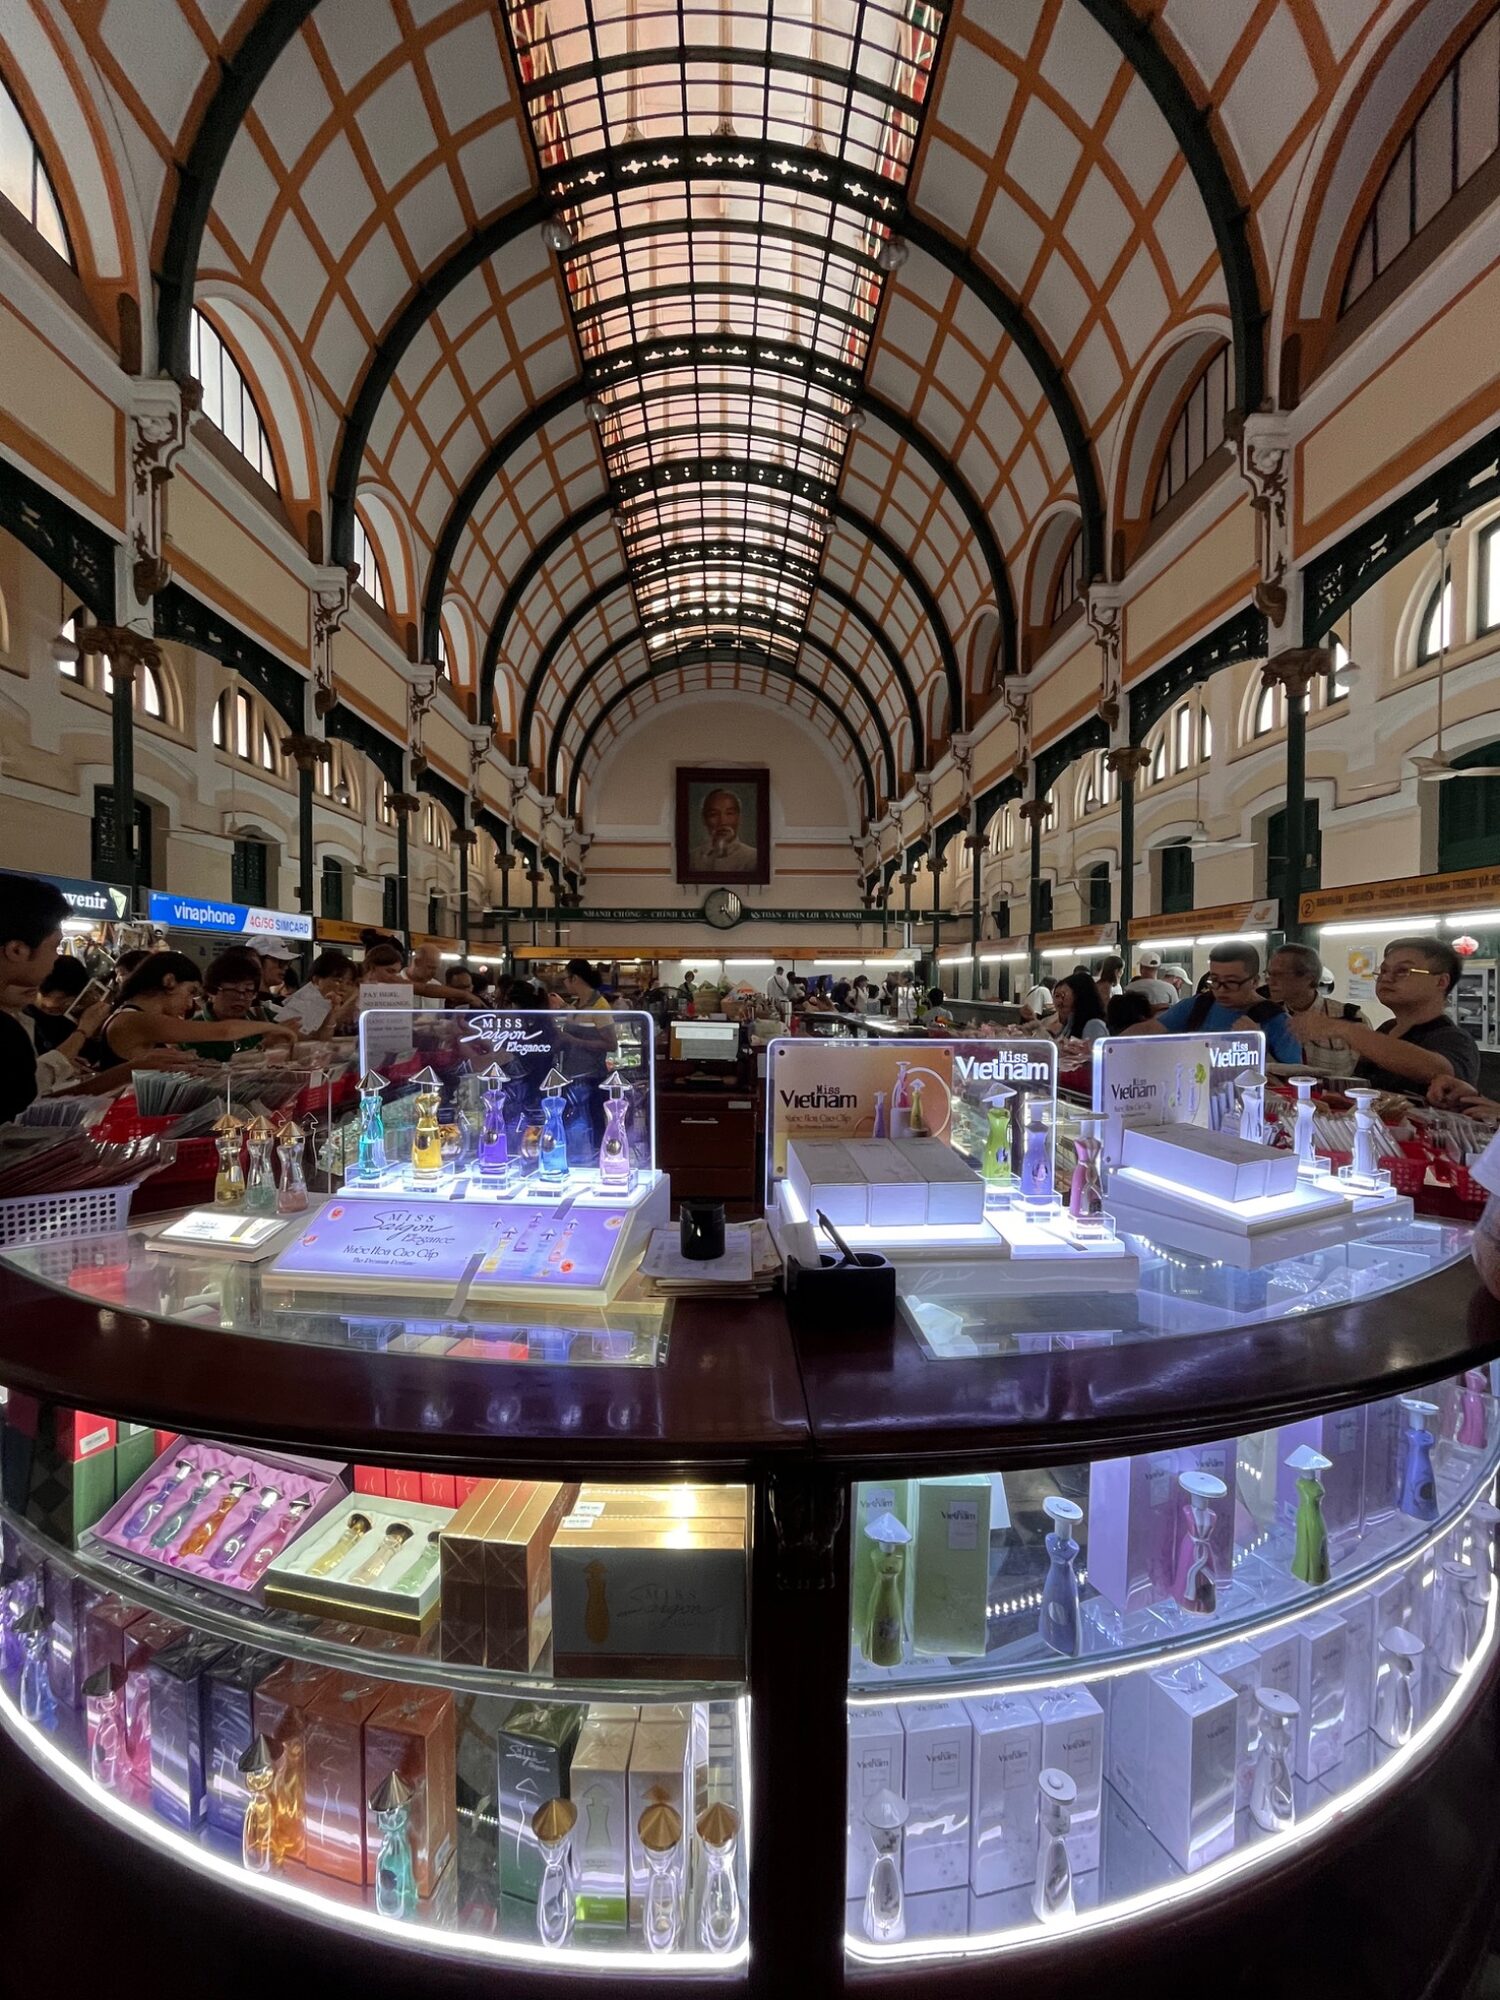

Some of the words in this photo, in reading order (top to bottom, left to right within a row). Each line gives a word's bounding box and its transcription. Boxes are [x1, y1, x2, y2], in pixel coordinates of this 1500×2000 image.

[63, 891, 108, 910] venir
[173, 901, 236, 925] vinaphone
[250, 915, 275, 930] 4G/5G
[275, 917, 309, 935] SIMCARD
[459, 1013, 543, 1052] Saigon
[482, 1018, 522, 1029] MISS
[506, 1041, 551, 1055] Elegance
[1231, 1041, 1249, 1051] Miss
[998, 1051, 1029, 1063] Miss
[1209, 1048, 1259, 1068] Vietnam
[955, 1056, 1049, 1080] Vietnam
[816, 1084, 841, 1095] Miss
[1111, 1083, 1157, 1100] Vietnam
[779, 1089, 857, 1109] Vietnam
[353, 1209, 455, 1241] Saigon
[389, 1213, 436, 1223] MISS
[392, 1247, 415, 1258] Cao
